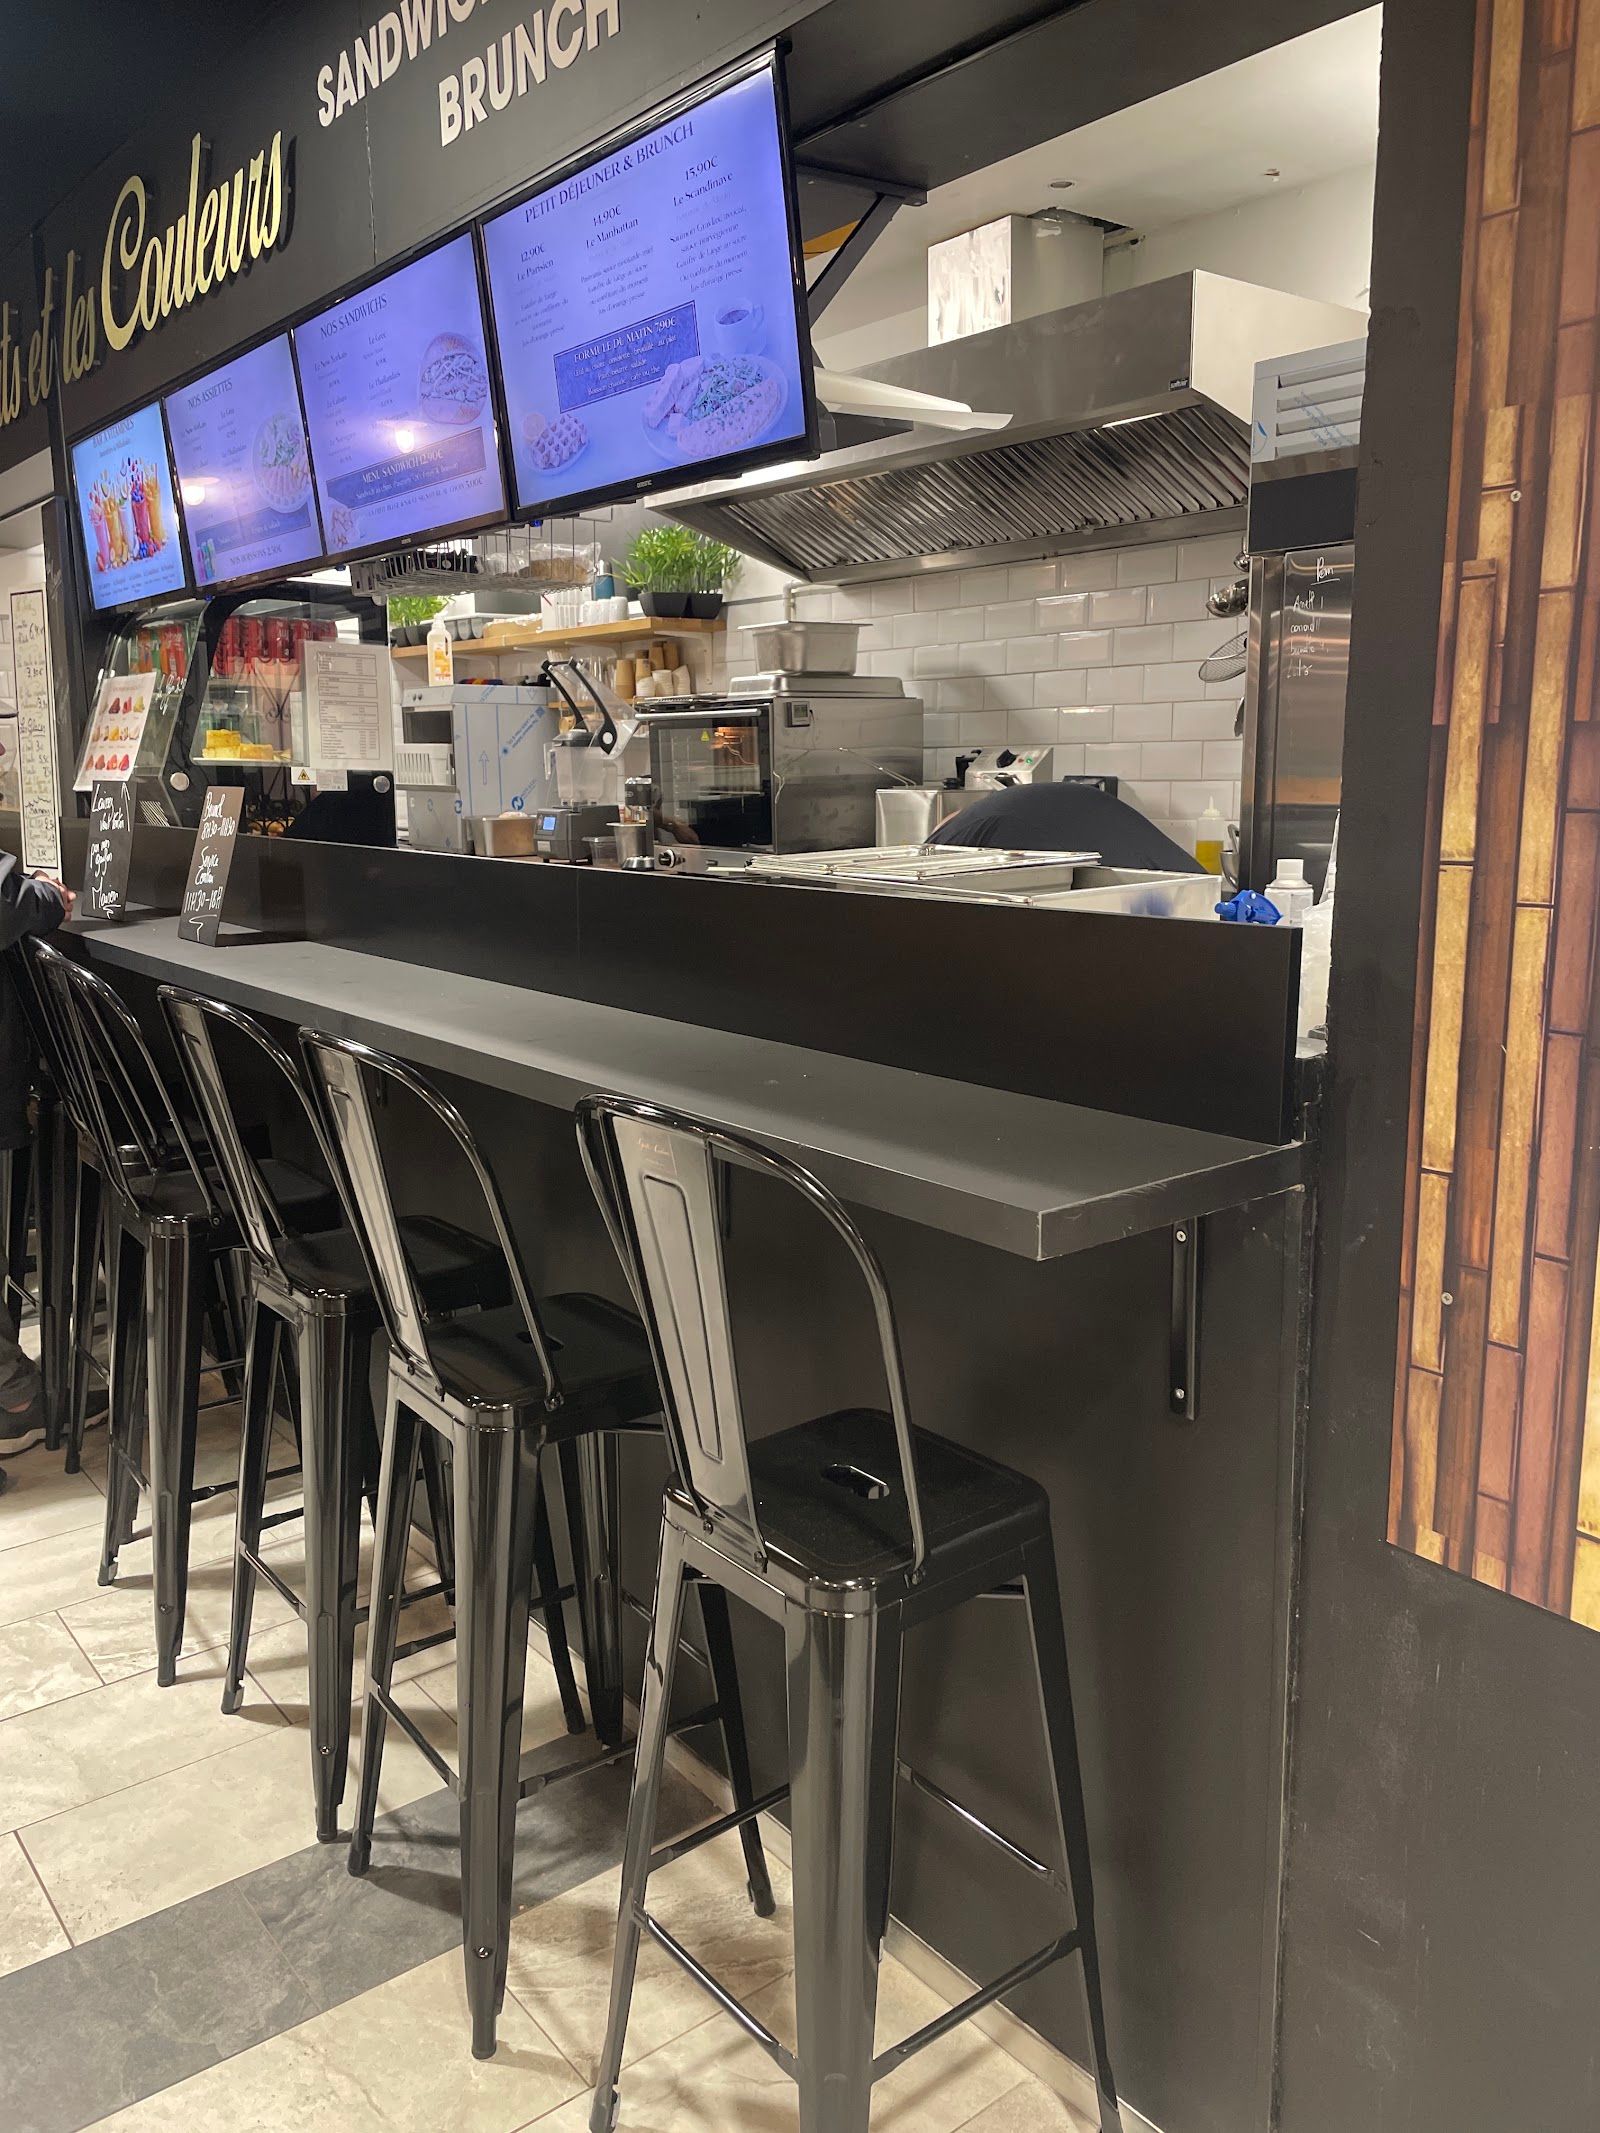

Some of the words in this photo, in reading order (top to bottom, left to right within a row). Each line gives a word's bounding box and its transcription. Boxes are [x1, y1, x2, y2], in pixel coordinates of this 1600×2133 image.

[438, 0, 620, 147] BRUNCH
[524, 194, 558, 224] PETIT
[558, 159, 622, 208] DÉJEUNER
[622, 153, 633, 171] &
[636, 120, 694, 164] BRUNCH
[672, 192, 684, 207] Le
[684, 168, 733, 202] Scandinave
[585, 235, 596, 249] Le
[596, 214, 639, 244] Manhattan
[28, 266, 58, 407] et
[63, 249, 95, 385] les
[101, 130, 282, 351] Couleurs
[516, 269, 526, 282] Le
[525, 256, 554, 278] Parisien
[319, 319, 338, 339] NOS
[337, 292, 388, 330] SANDWICHS
[573, 340, 611, 363] FORMULE
[612, 335, 624, 348] DU
[626, 324, 653, 343] MATIN
[187, 393, 201, 410] NOS
[200, 377, 233, 403] ASSIETTES
[361, 469, 380, 483] MENU
[381, 456, 419, 477] SANDWICH
